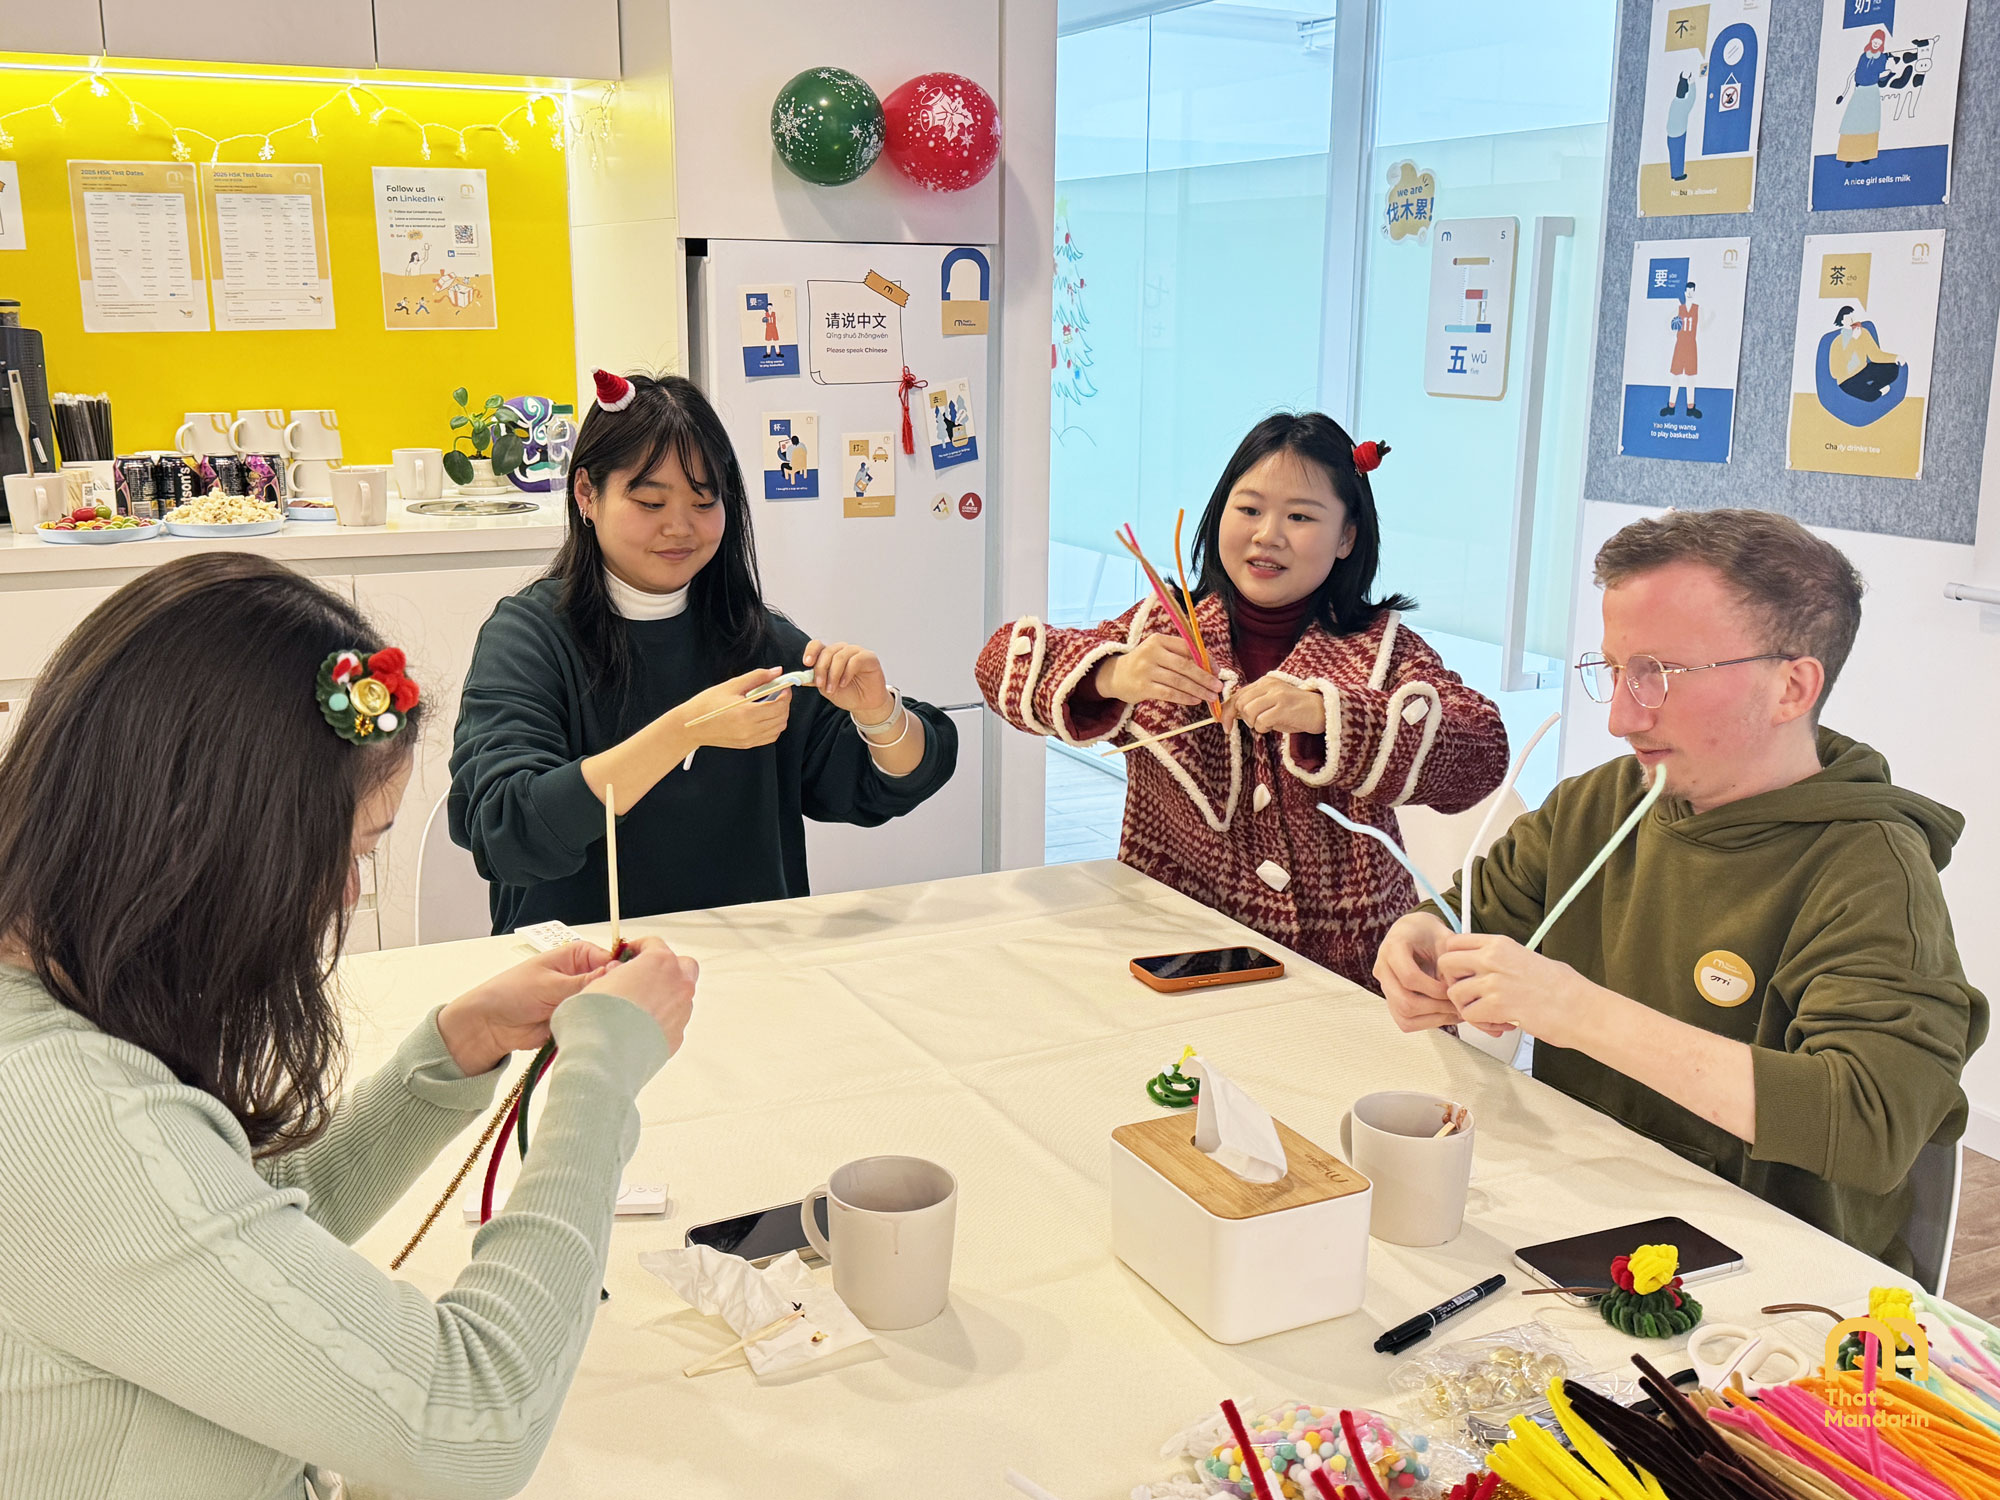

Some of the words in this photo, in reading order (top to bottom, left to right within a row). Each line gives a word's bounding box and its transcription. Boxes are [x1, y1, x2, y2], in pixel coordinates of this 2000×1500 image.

[1675, 20, 1689, 38] 不
[1866, 176, 1877, 186] girl
[1895, 174, 1911, 182] milk
[400, 194, 435, 202] LinkedIn
[1397, 189, 1408, 197] we
[1410, 186, 1423, 194] are
[1387, 197, 1434, 225] 伐木累!
[1501, 230, 1506, 239] 5
[1654, 269, 1668, 288] 要
[1830, 266, 1846, 285] 茶
[825, 312, 887, 329] 请说中文
[1684, 317, 1692, 331] 11
[1447, 345, 1467, 374] 五
[1670, 431, 1699, 439] basketball
[1847, 444, 1867, 452] drinks
